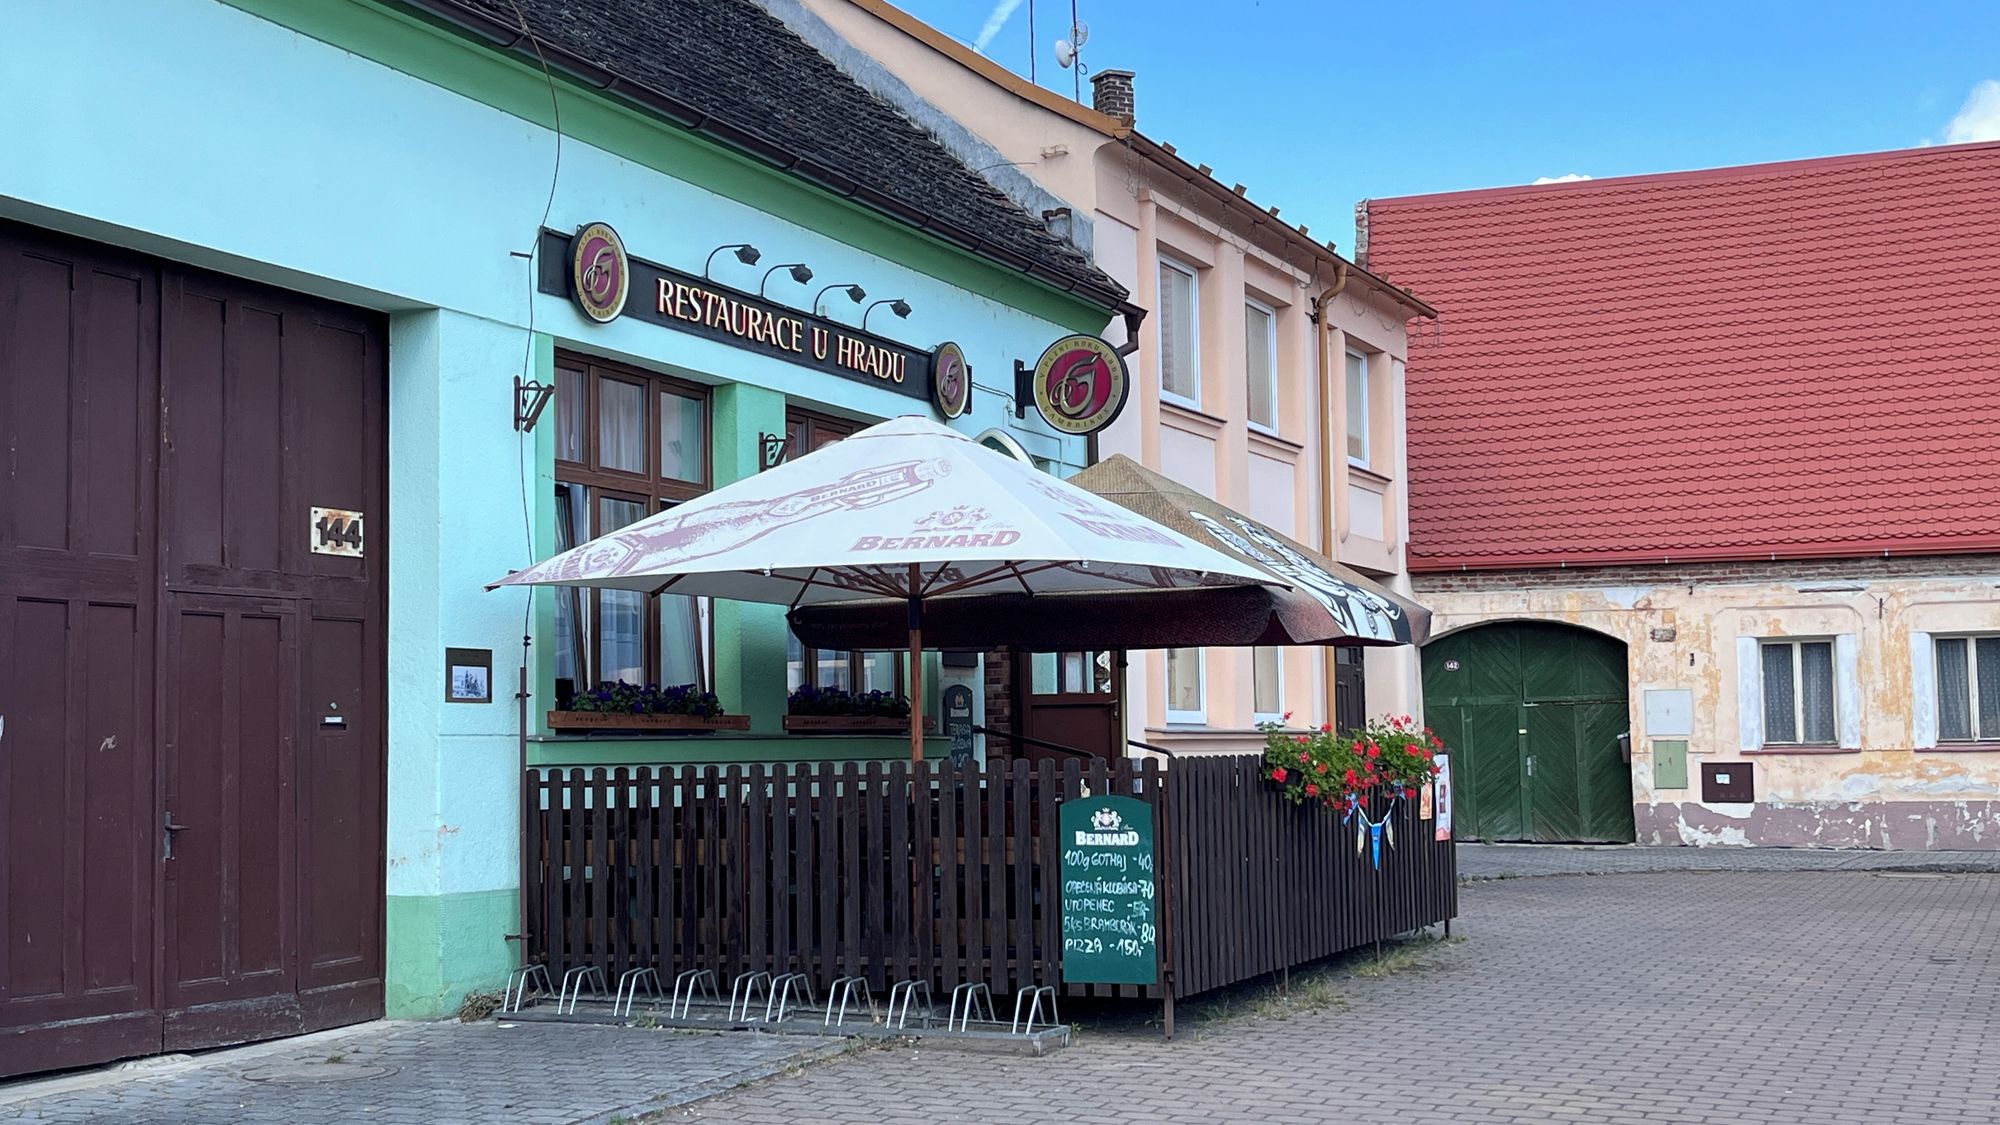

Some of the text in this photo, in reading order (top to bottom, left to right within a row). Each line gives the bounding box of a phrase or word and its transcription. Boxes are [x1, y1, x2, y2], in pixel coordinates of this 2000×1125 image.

[656, 277, 803, 353] RESTAURACE
[812, 327, 829, 360] U
[837, 334, 906, 383] HRADU
[315, 516, 362, 549] 144
[851, 530, 1022, 552] BERNARD
[1075, 830, 1140, 846] BERNARD
[1064, 898, 1115, 913] UTOPENEC
[1064, 938, 1103, 953] PIZZA
